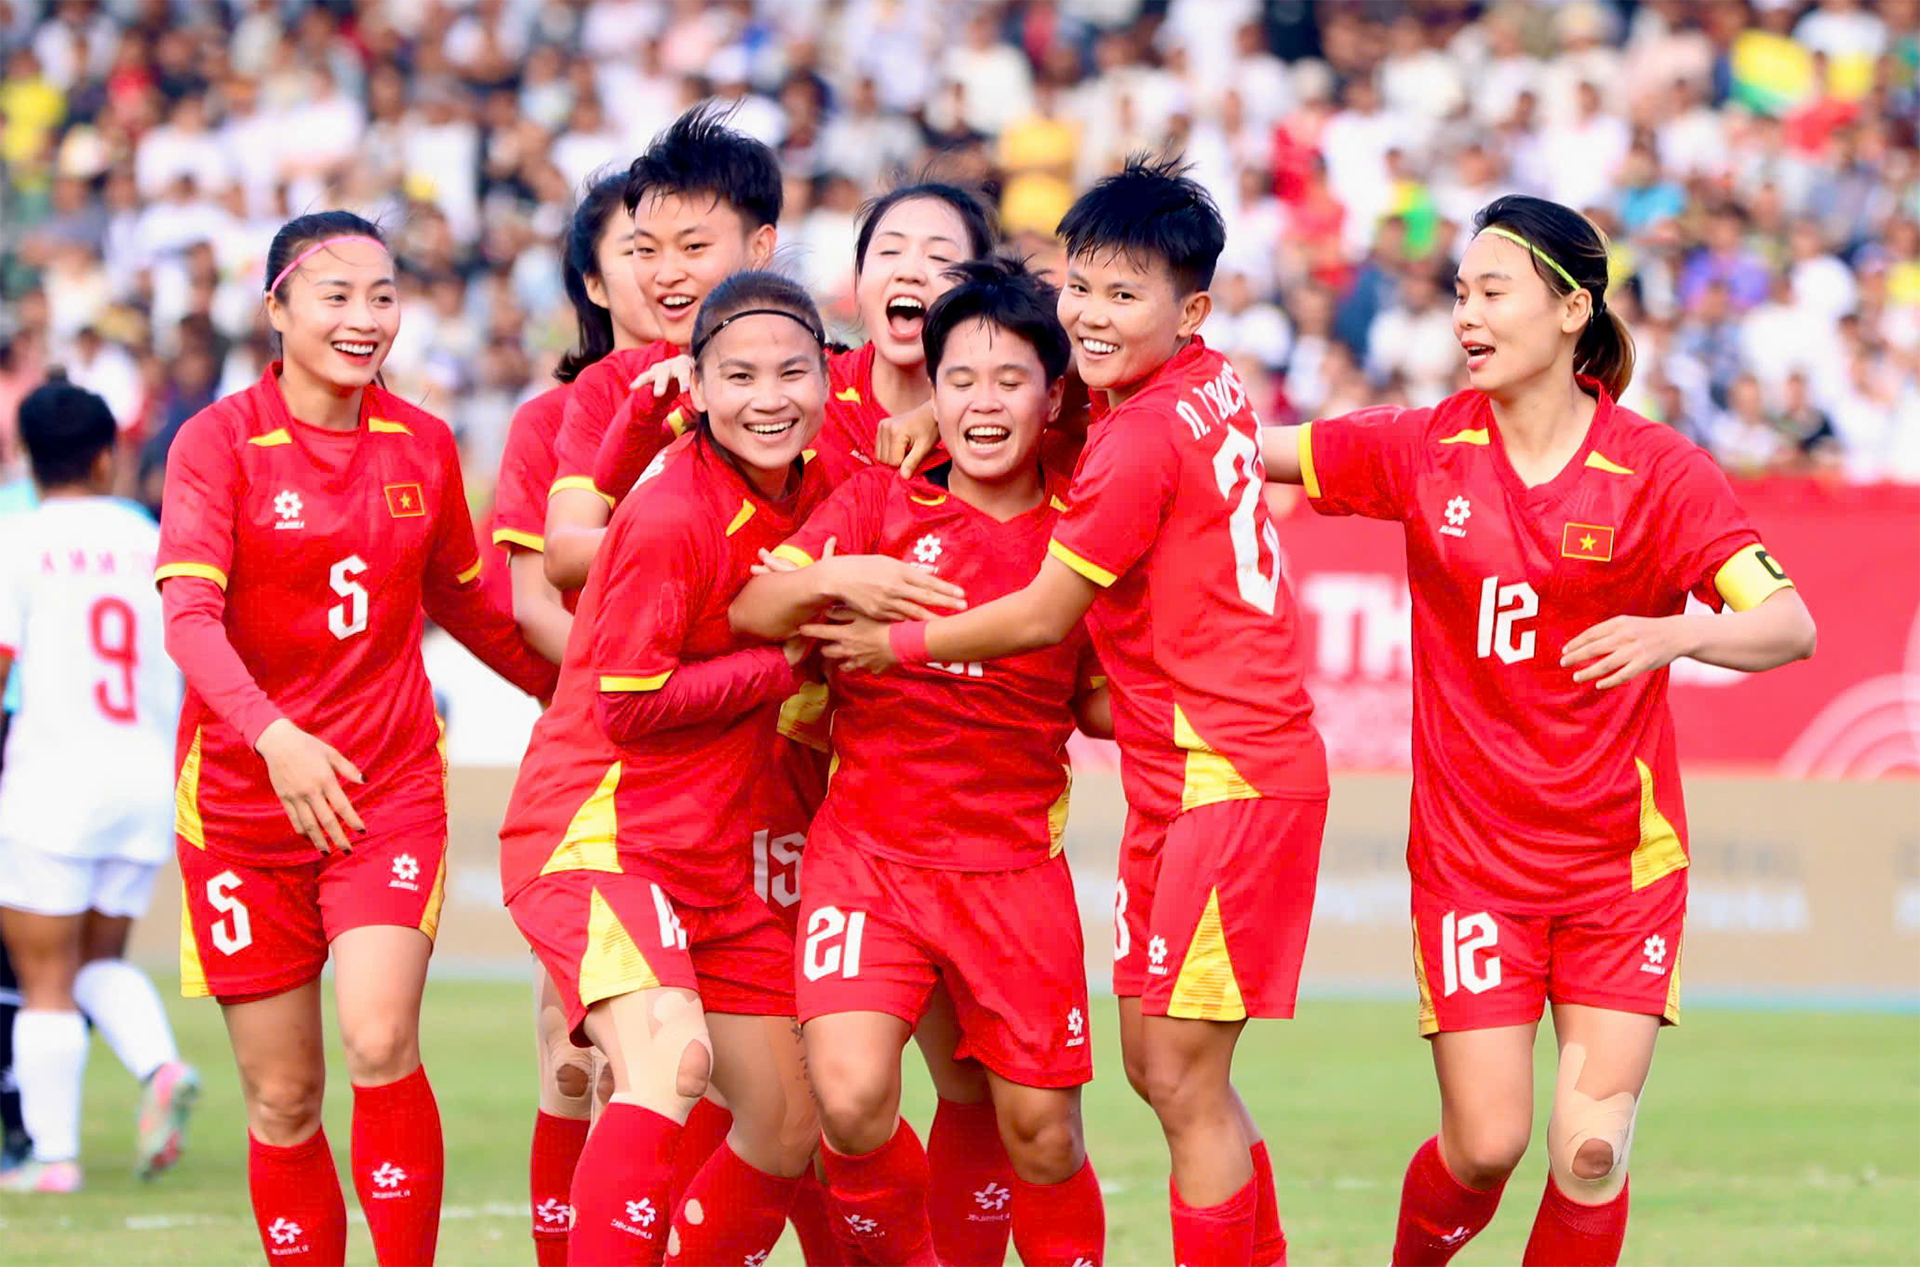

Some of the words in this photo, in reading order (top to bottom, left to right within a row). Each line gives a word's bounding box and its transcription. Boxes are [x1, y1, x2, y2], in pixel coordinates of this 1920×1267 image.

[328, 554, 368, 640] 5
[1477, 575, 1538, 665] 12
[89, 596, 138, 723] 9
[753, 829, 803, 908] 15
[206, 870, 252, 956] 5
[803, 905, 866, 979] 21
[1442, 911, 1502, 997] 12
